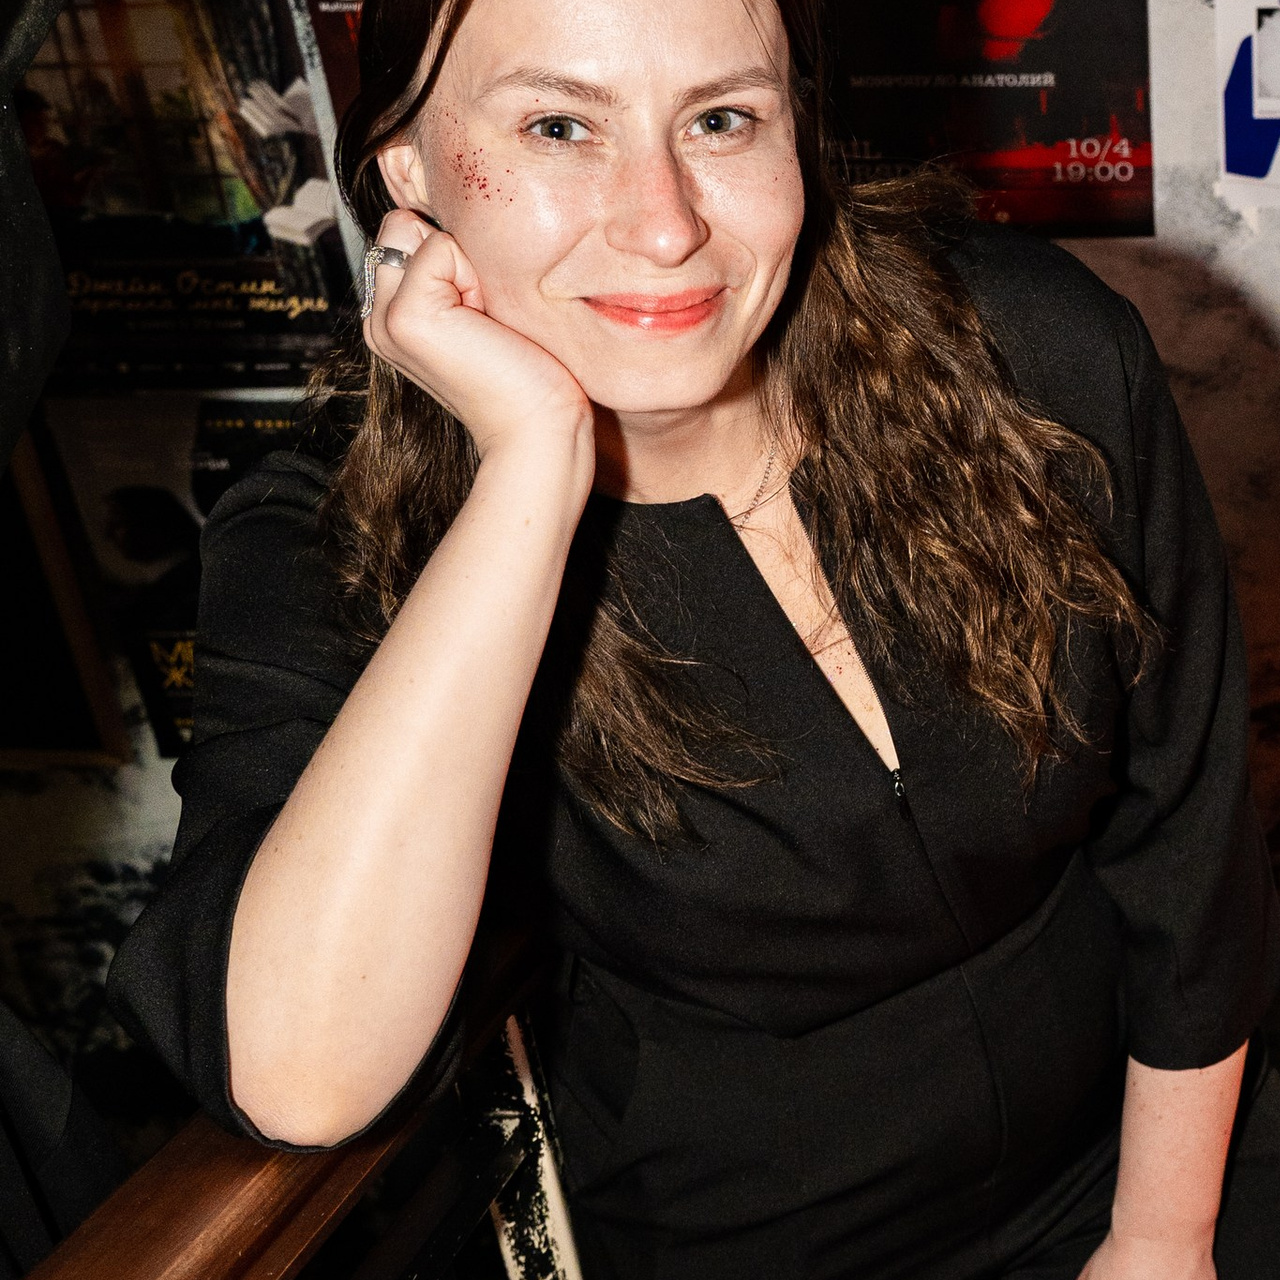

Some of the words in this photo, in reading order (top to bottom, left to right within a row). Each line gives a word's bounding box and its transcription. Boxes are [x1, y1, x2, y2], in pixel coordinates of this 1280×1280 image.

[962, 71, 1057, 87] АНАТОЛИЙ
[1066, 137, 1132, 159] 10/4
[1051, 160, 1135, 183] 19:00
